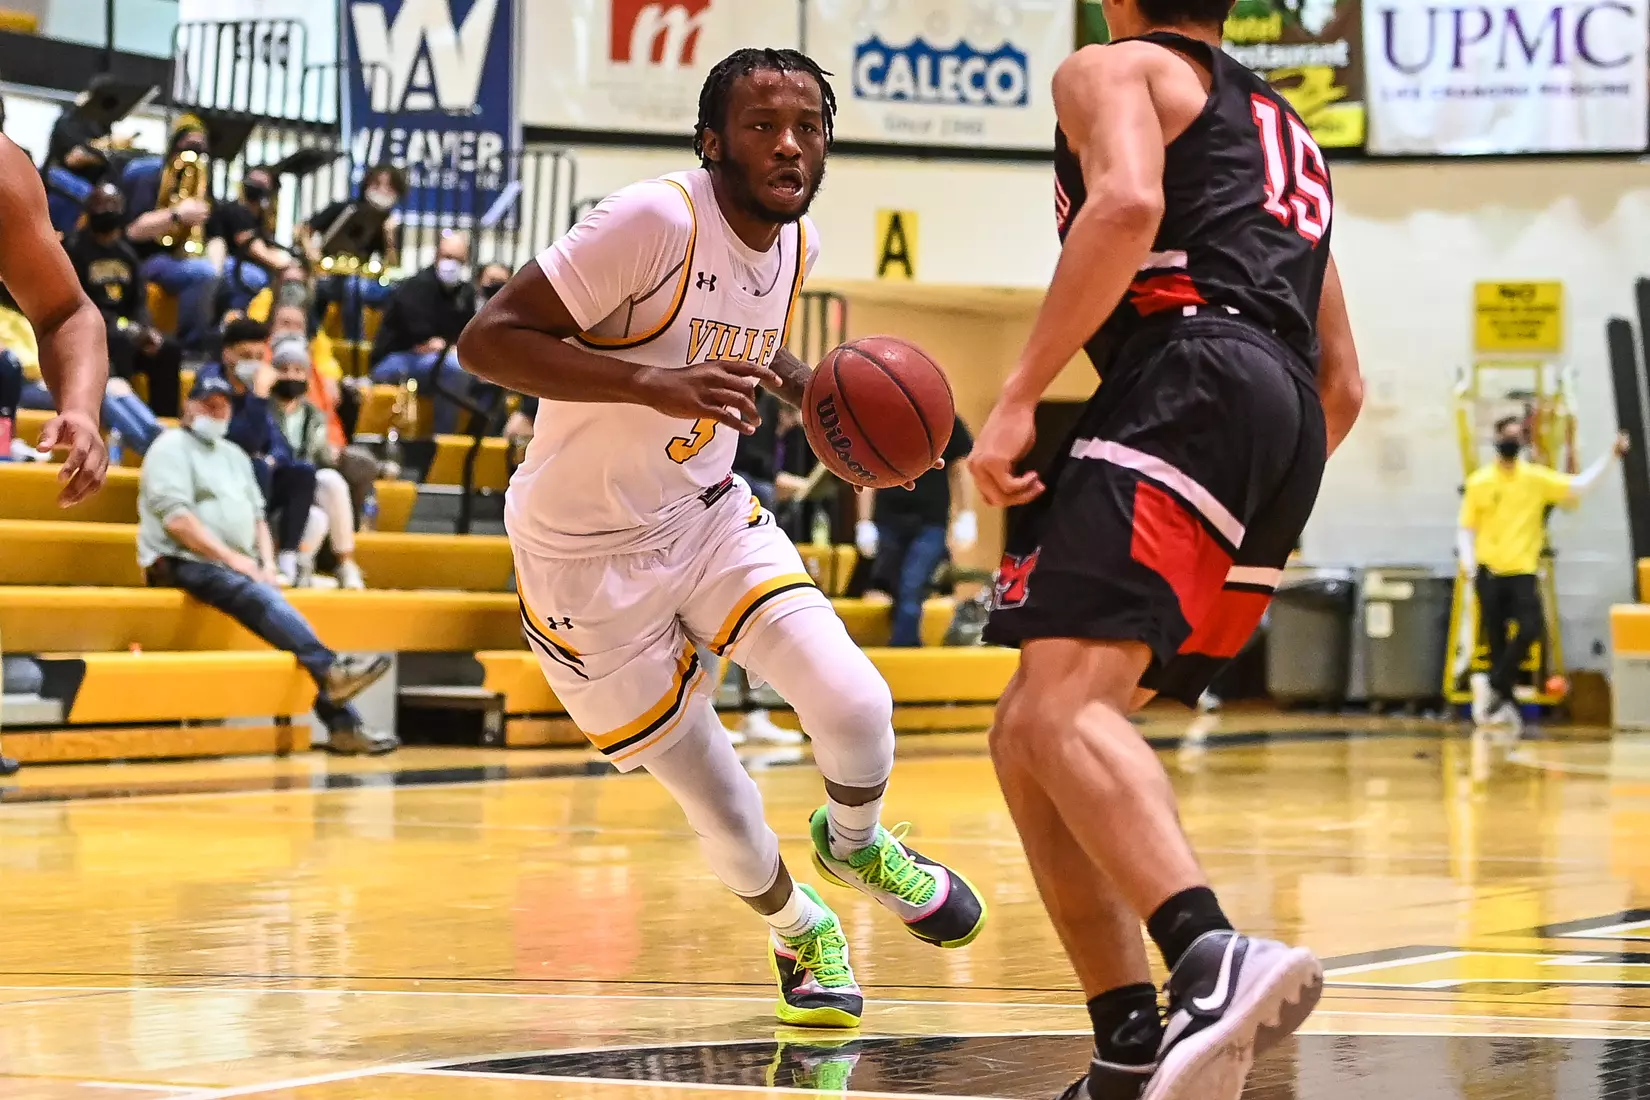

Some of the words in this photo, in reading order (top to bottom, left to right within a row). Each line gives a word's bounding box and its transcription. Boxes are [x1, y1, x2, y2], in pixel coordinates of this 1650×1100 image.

[1378, 2, 1635, 74] UPMC
[857, 51, 1025, 101] CALECO
[1250, 92, 1332, 249] 15
[878, 212, 914, 278] A
[686, 318, 779, 367] VILLE
[817, 393, 878, 482] Wilson
